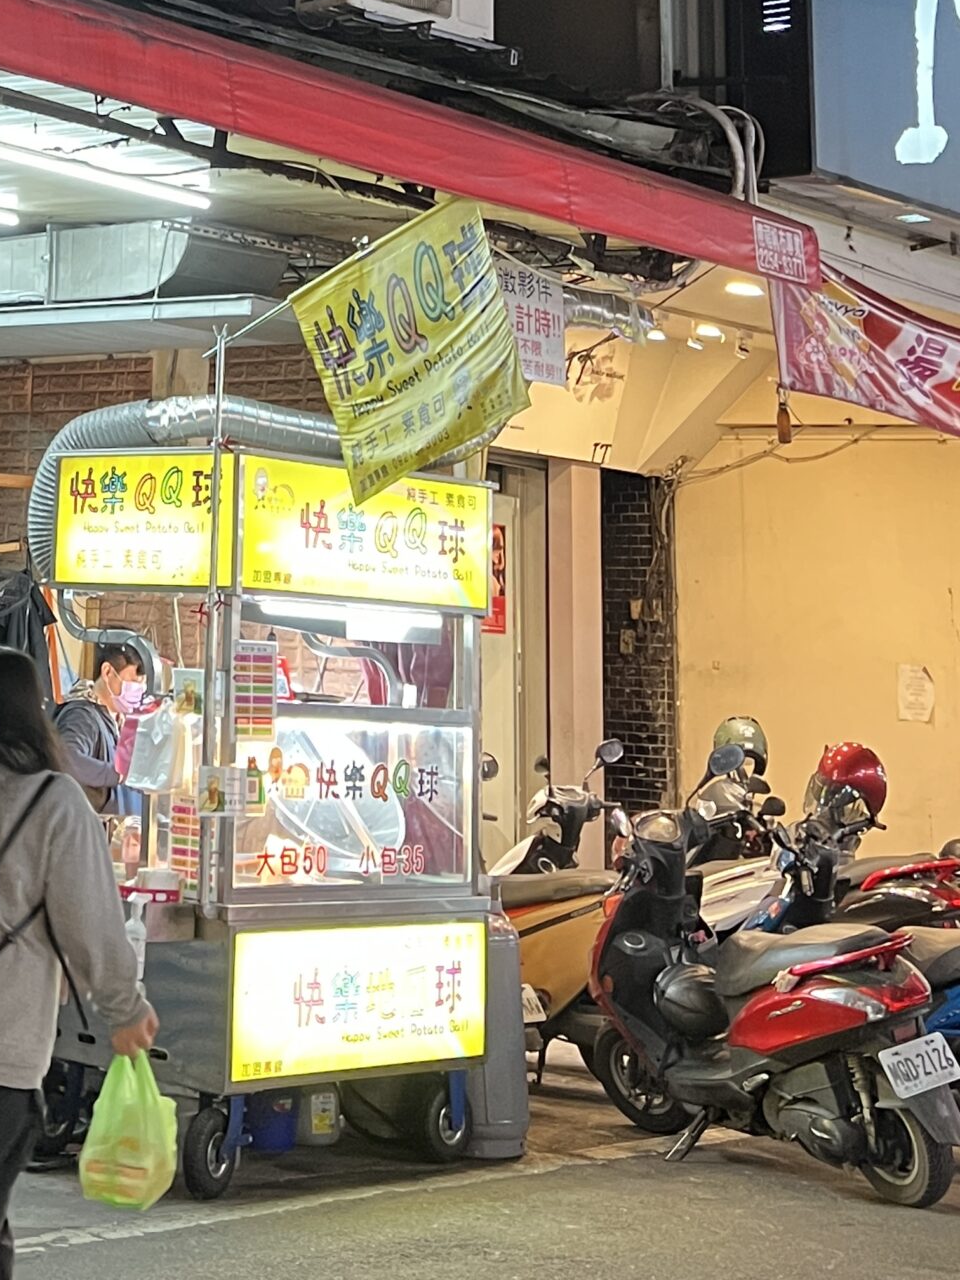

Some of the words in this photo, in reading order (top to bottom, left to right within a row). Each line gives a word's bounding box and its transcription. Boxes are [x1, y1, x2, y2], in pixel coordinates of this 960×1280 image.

[386, 369, 423, 398] Sweet
[300, 499, 466, 563] 快樂QQ球
[315, 758, 440, 802] 快樂QQ球
[256, 845, 329, 877] 大包50
[359, 844, 426, 877] 小包35
